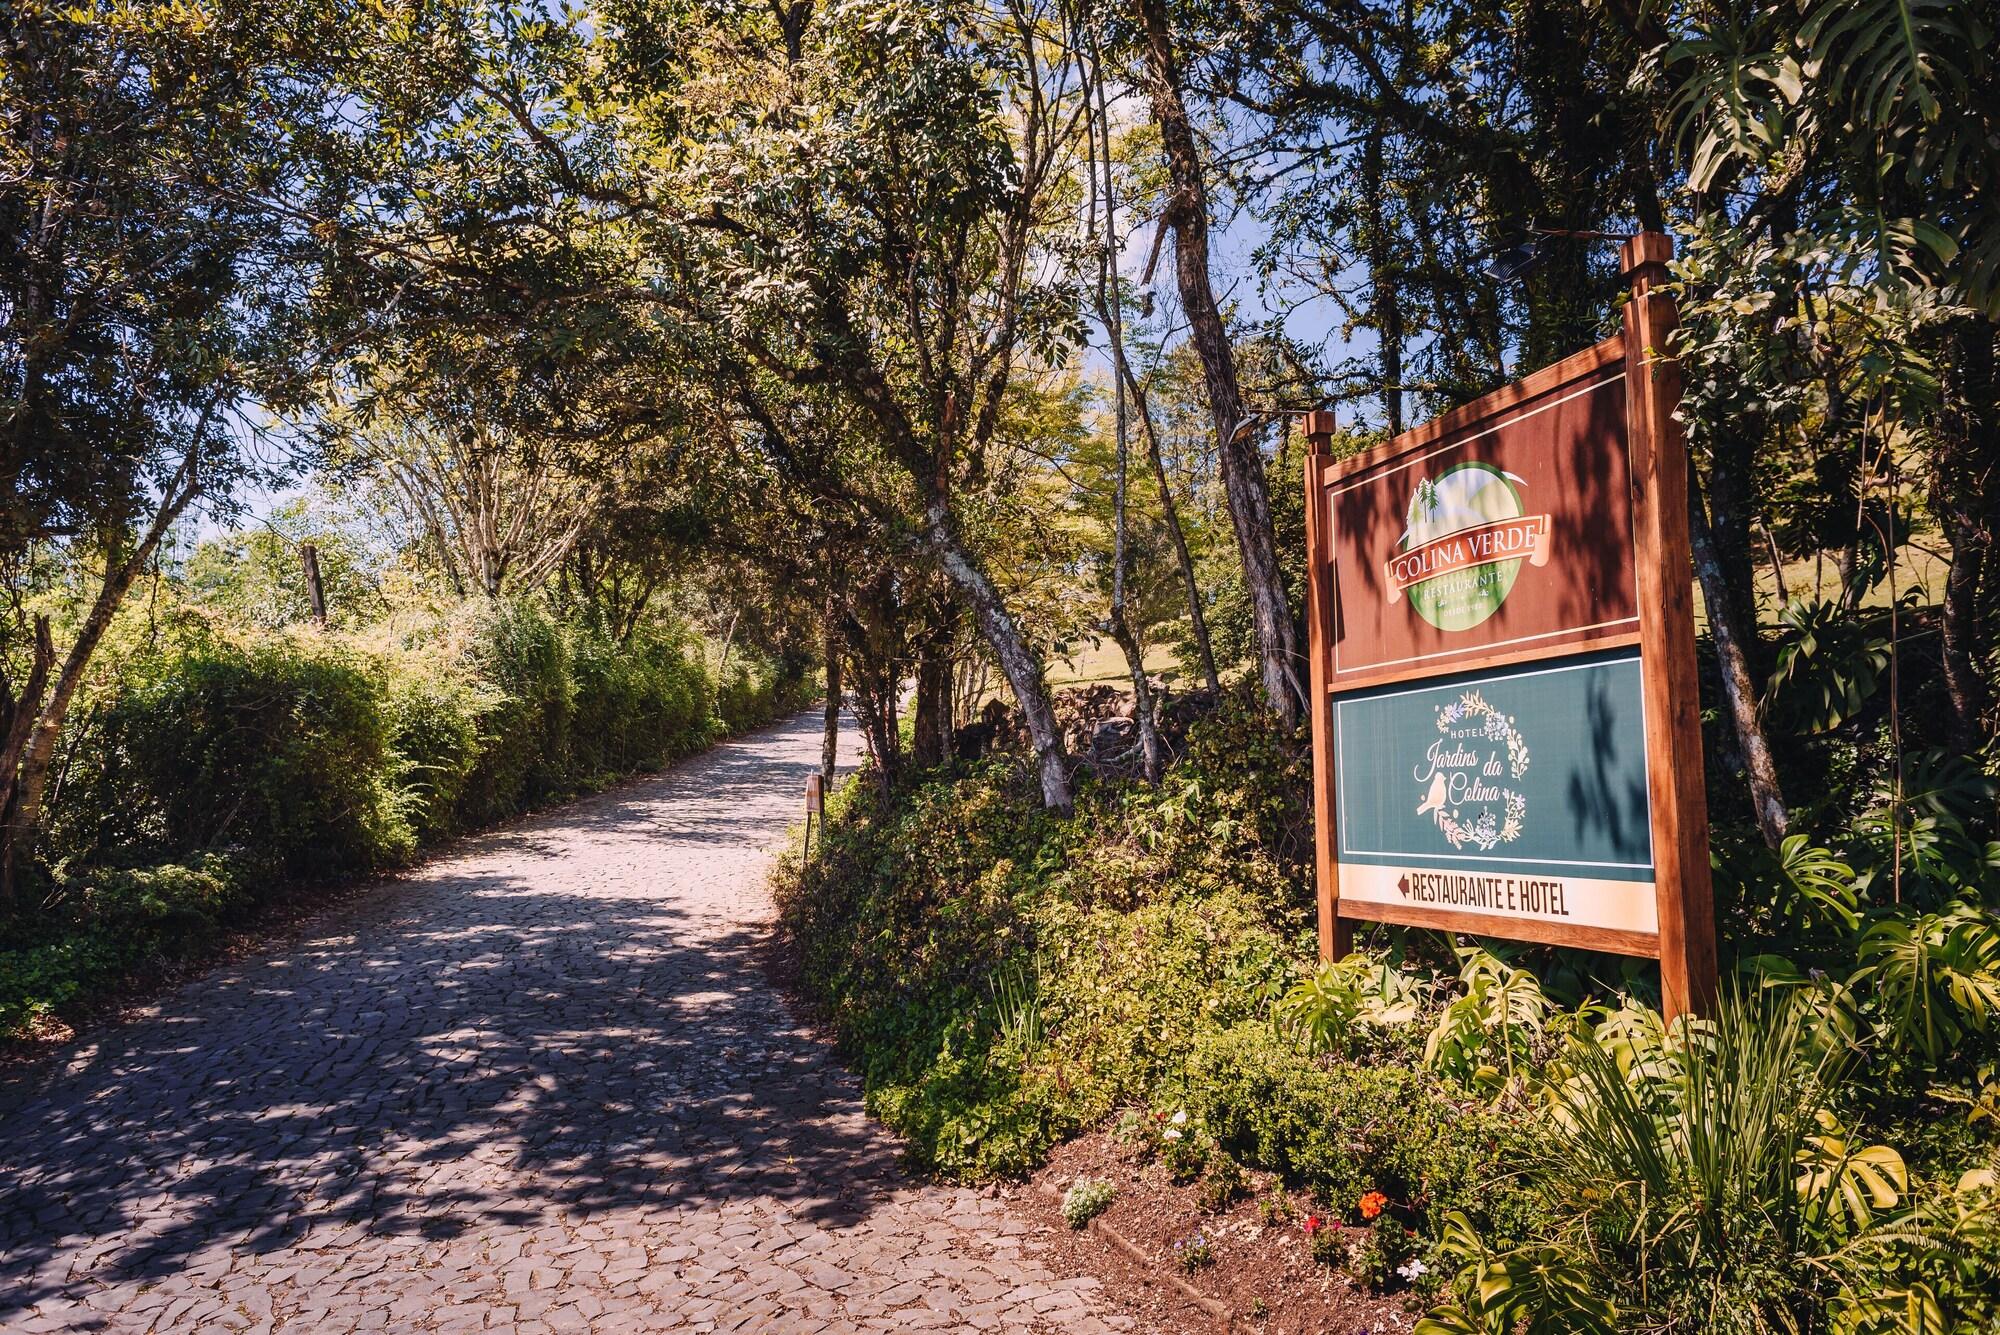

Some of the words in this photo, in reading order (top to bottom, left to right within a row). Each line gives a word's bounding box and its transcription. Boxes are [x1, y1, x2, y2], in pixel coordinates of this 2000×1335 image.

[1395, 541, 1465, 581] COLINA
[1467, 525, 1536, 557] VERDE
[1423, 570, 1503, 600] RESTAURANTE
[1450, 728, 1485, 739] HOTEL
[1413, 738, 1479, 782] Jardins
[1483, 751, 1503, 776] da
[1448, 771, 1501, 805] Colina
[1412, 873, 1503, 909] RESTAURANTE
[1507, 879, 1516, 910] E
[1519, 880, 1569, 916] HOTEL
